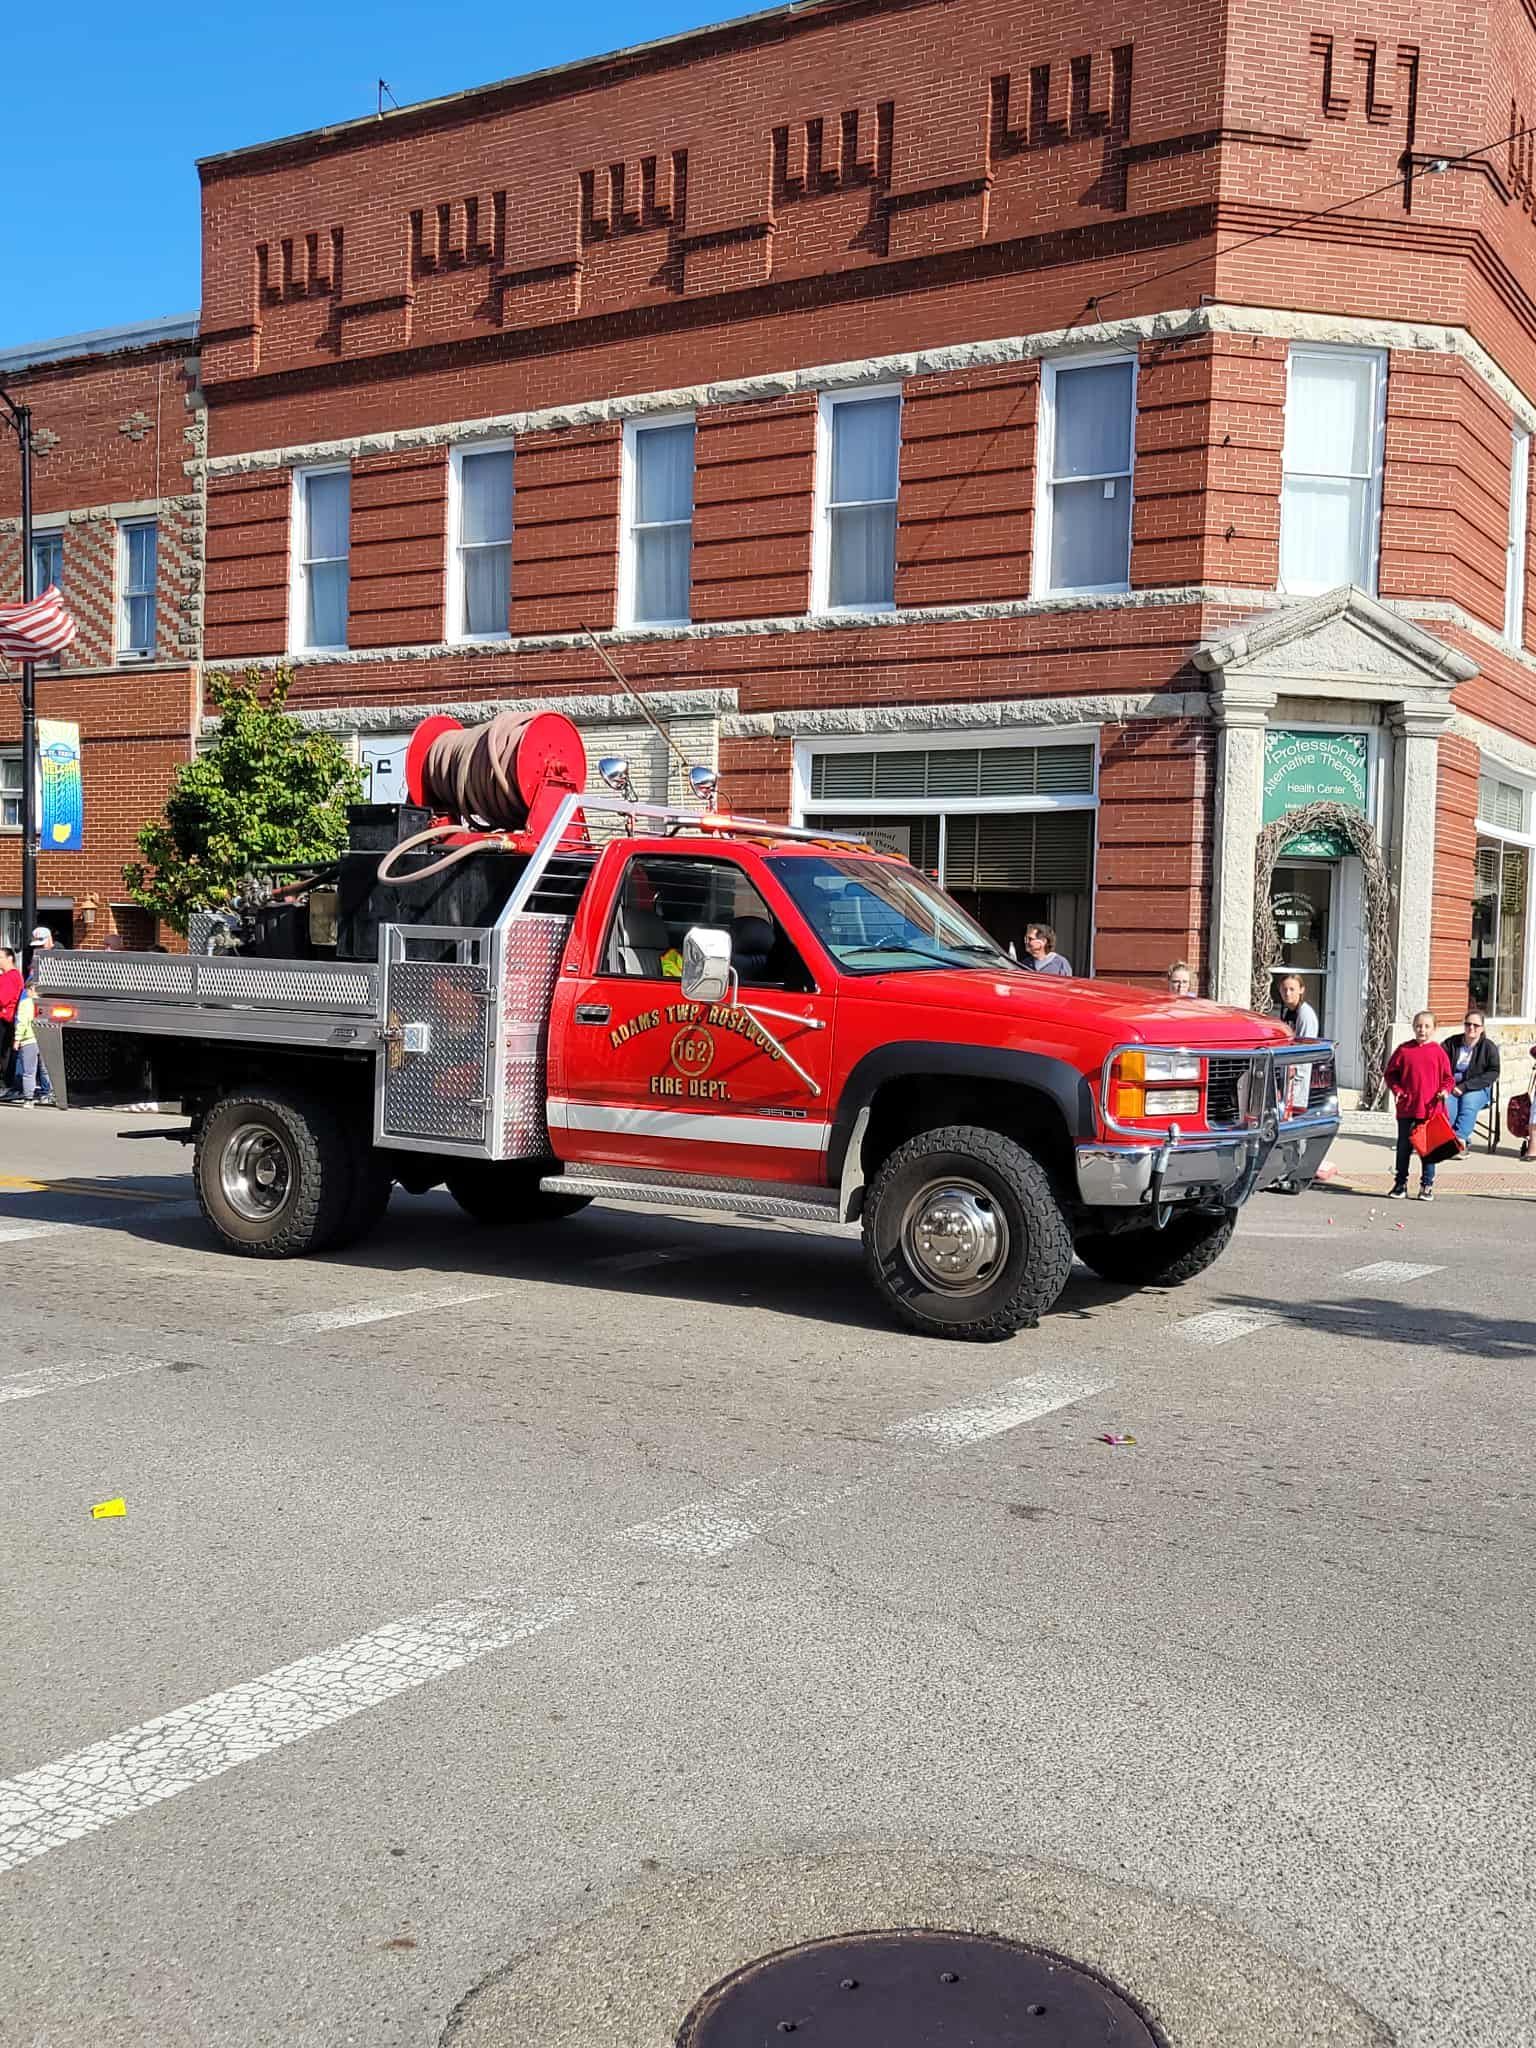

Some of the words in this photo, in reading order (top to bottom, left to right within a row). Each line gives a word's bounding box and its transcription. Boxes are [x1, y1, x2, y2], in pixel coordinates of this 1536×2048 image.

[1272, 740, 1365, 768] Professional
[1263, 752, 1316, 797] Alternative
[1319, 752, 1366, 800] Therapies
[1287, 783, 1315, 793] Health
[1317, 784, 1346, 794] Center
[609, 1009, 661, 1049] ADAMS
[666, 1004, 701, 1023] TWP.
[678, 1039, 707, 1062] 162
[651, 1076, 684, 1096] FIRE
[689, 1079, 731, 1099] DEPT.
